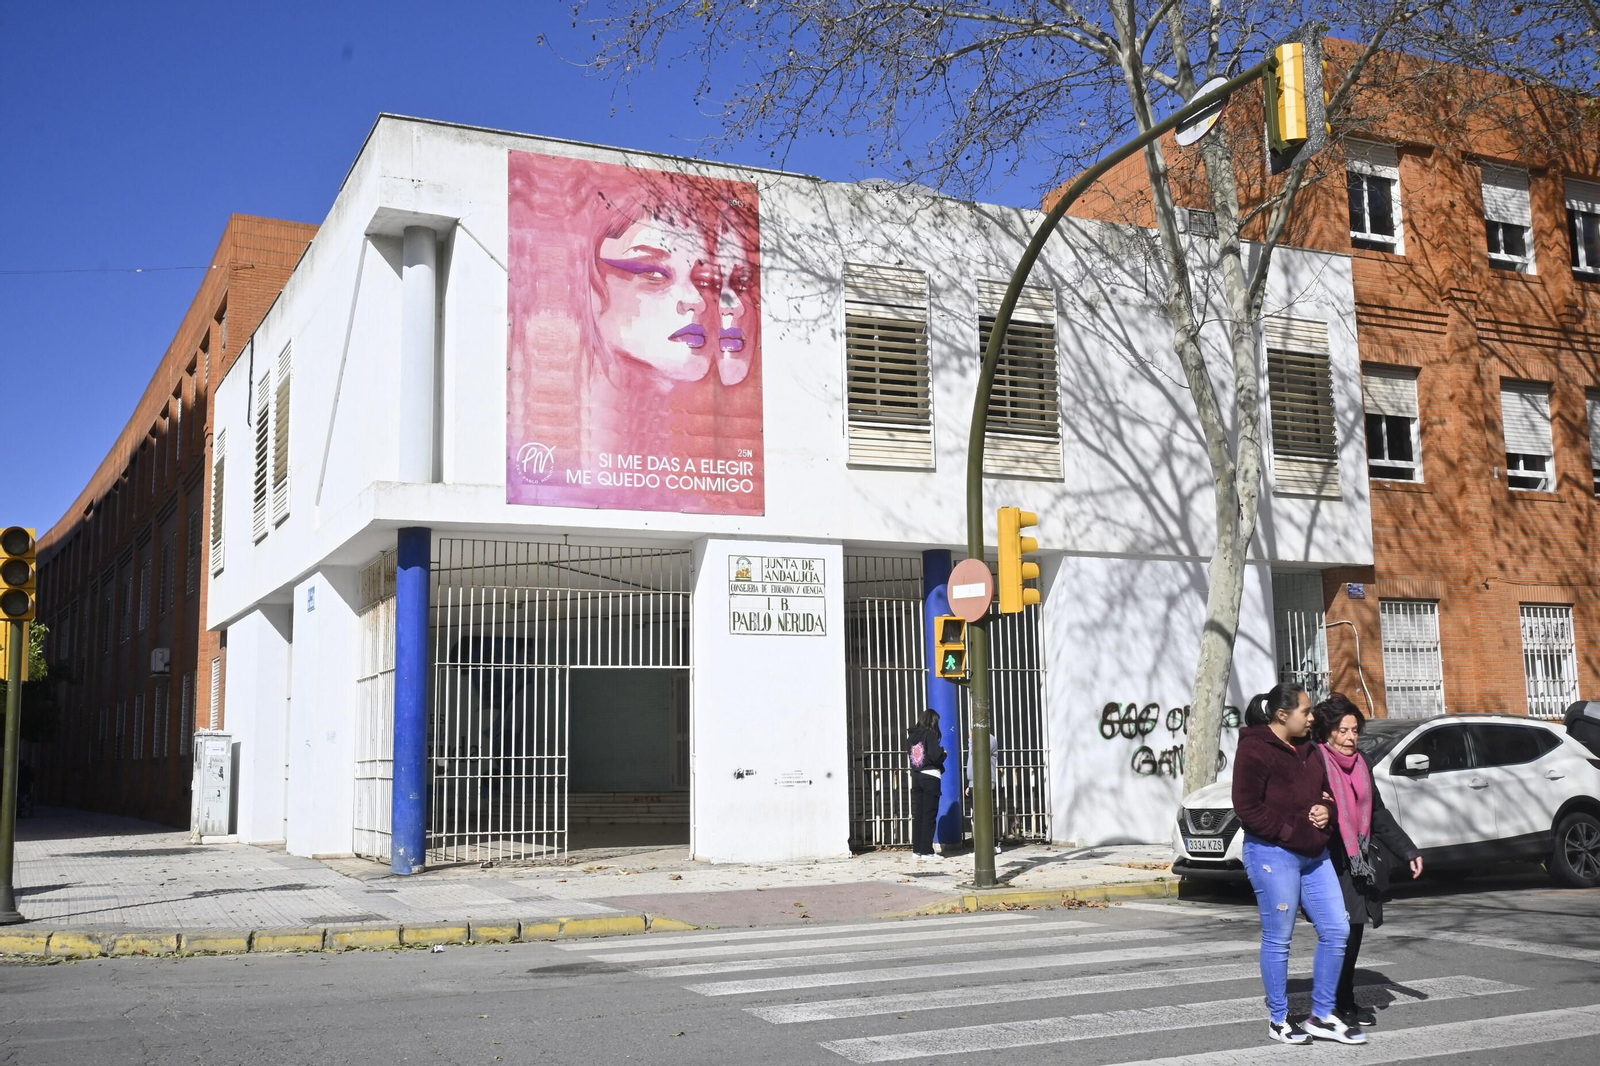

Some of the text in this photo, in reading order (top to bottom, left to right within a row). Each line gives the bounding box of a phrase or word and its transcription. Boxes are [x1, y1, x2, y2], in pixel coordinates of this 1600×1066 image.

[737, 449, 753, 458] 25N
[598, 453, 754, 476] SI ME DAS A ELEGIR
[566, 469, 754, 493] ME QUEDO CONMIGO
[764, 558, 815, 571] JUNTA DE
[764, 570, 820, 583] ANDALUCIA
[730, 583, 759, 593] CONSEJERIA
[761, 584, 767, 593] DE
[796, 586, 801, 594] Y
[802, 586, 824, 595] CIENCIA
[732, 611, 825, 633] PABLO NERUDA
[1189, 840, 1222, 851] 3334 KZS
